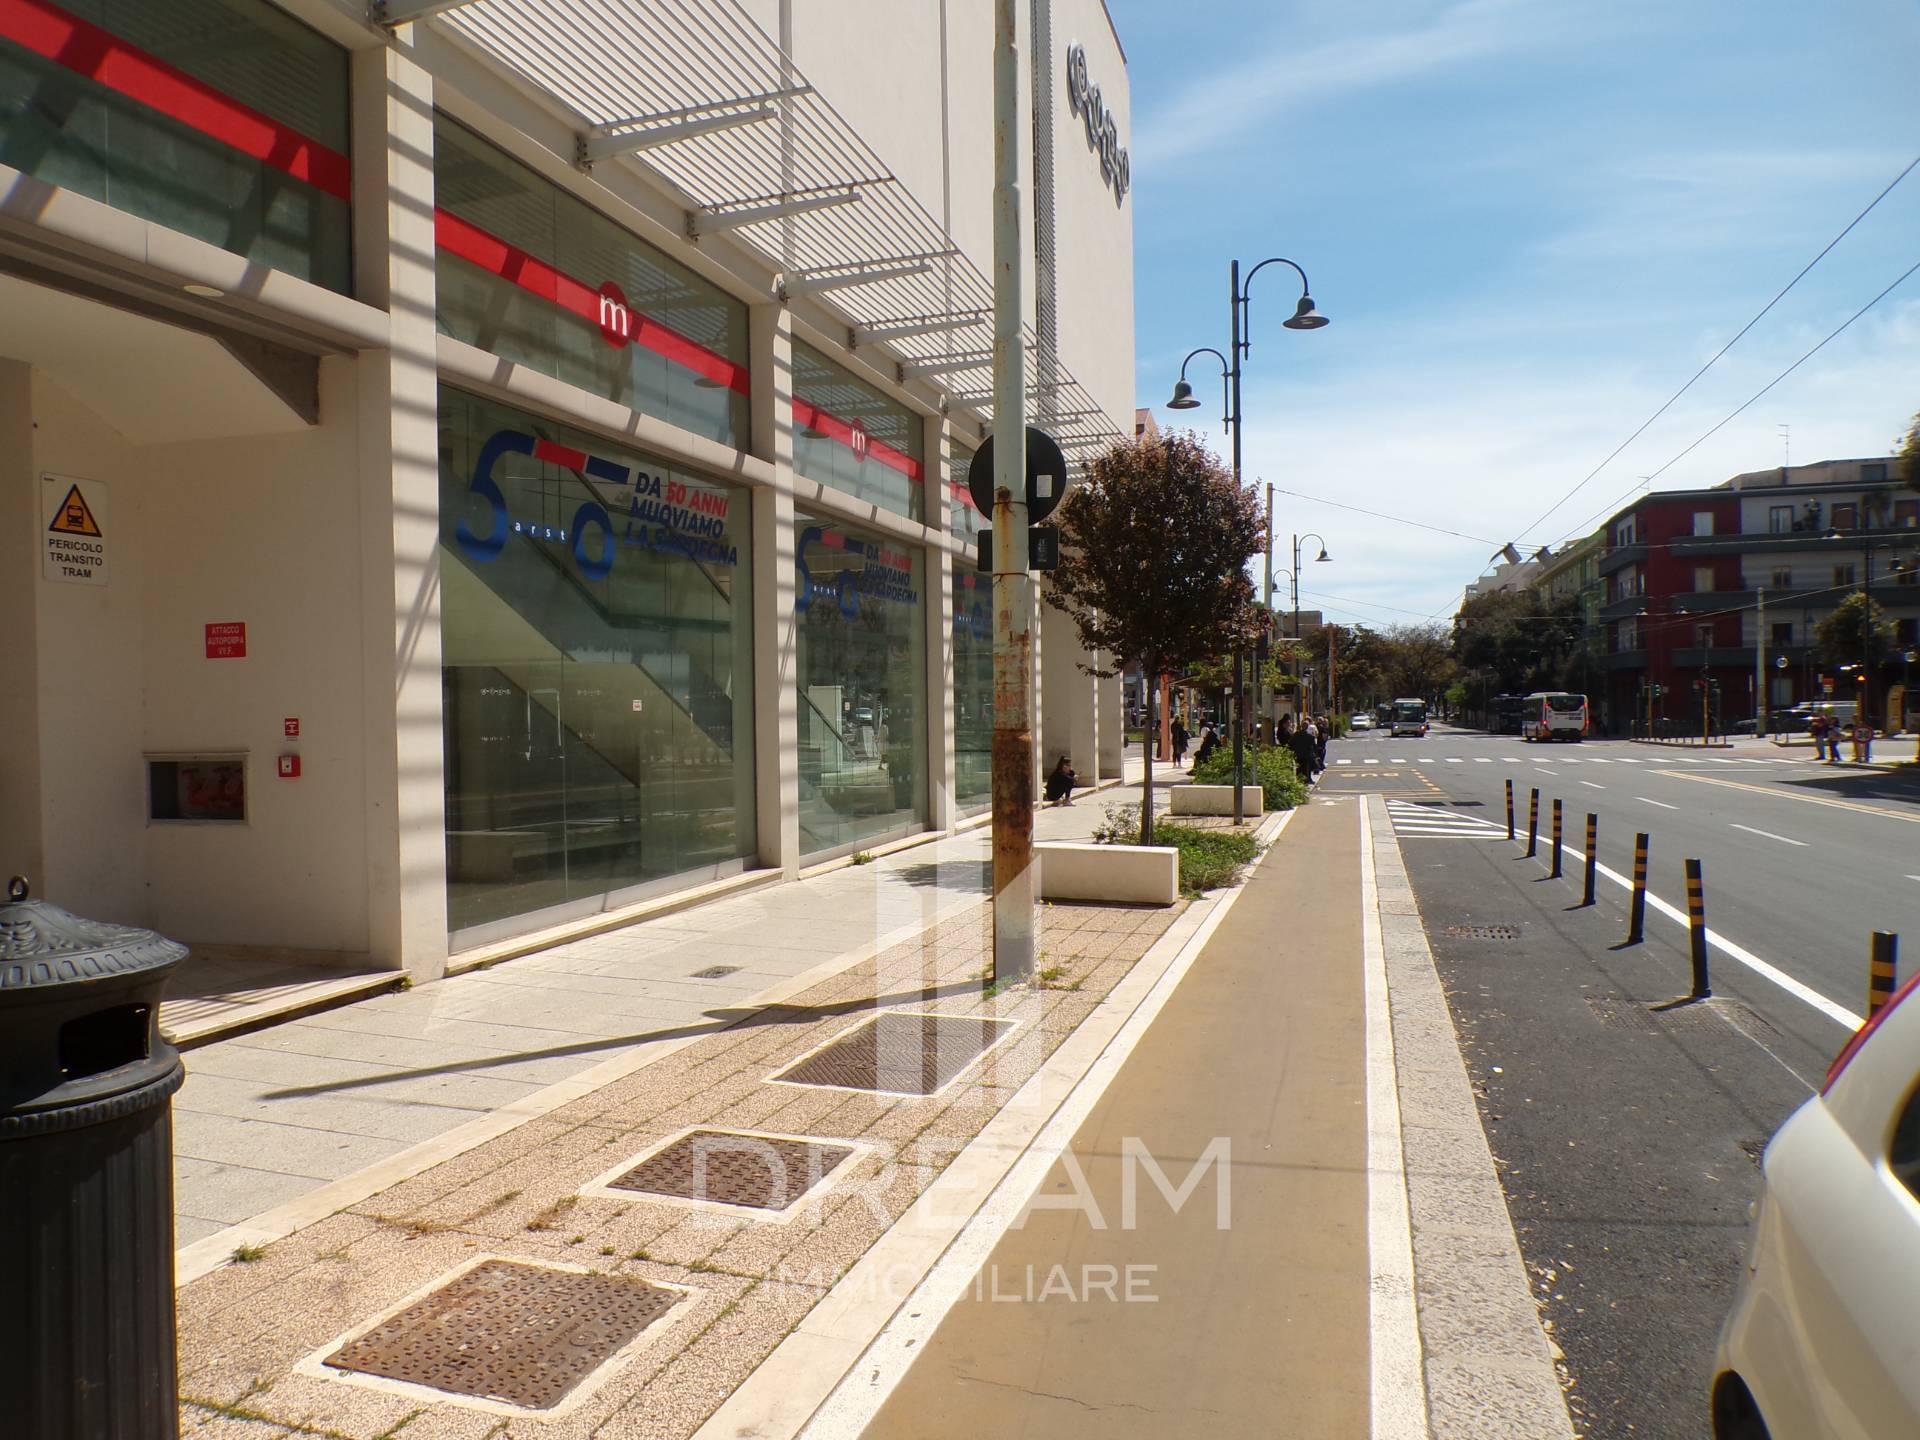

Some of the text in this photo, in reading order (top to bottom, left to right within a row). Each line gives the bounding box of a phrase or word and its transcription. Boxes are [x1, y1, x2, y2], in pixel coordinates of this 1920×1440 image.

[600, 294, 627, 337] m
[634, 472, 729, 518] DA 50 ANNI
[630, 496, 724, 539] MUOVIAMO
[514, 520, 567, 542] arst
[48, 538, 103, 553] PERICOLO
[50, 552, 103, 567] TRANSITO
[62, 566, 92, 579] TRAM
